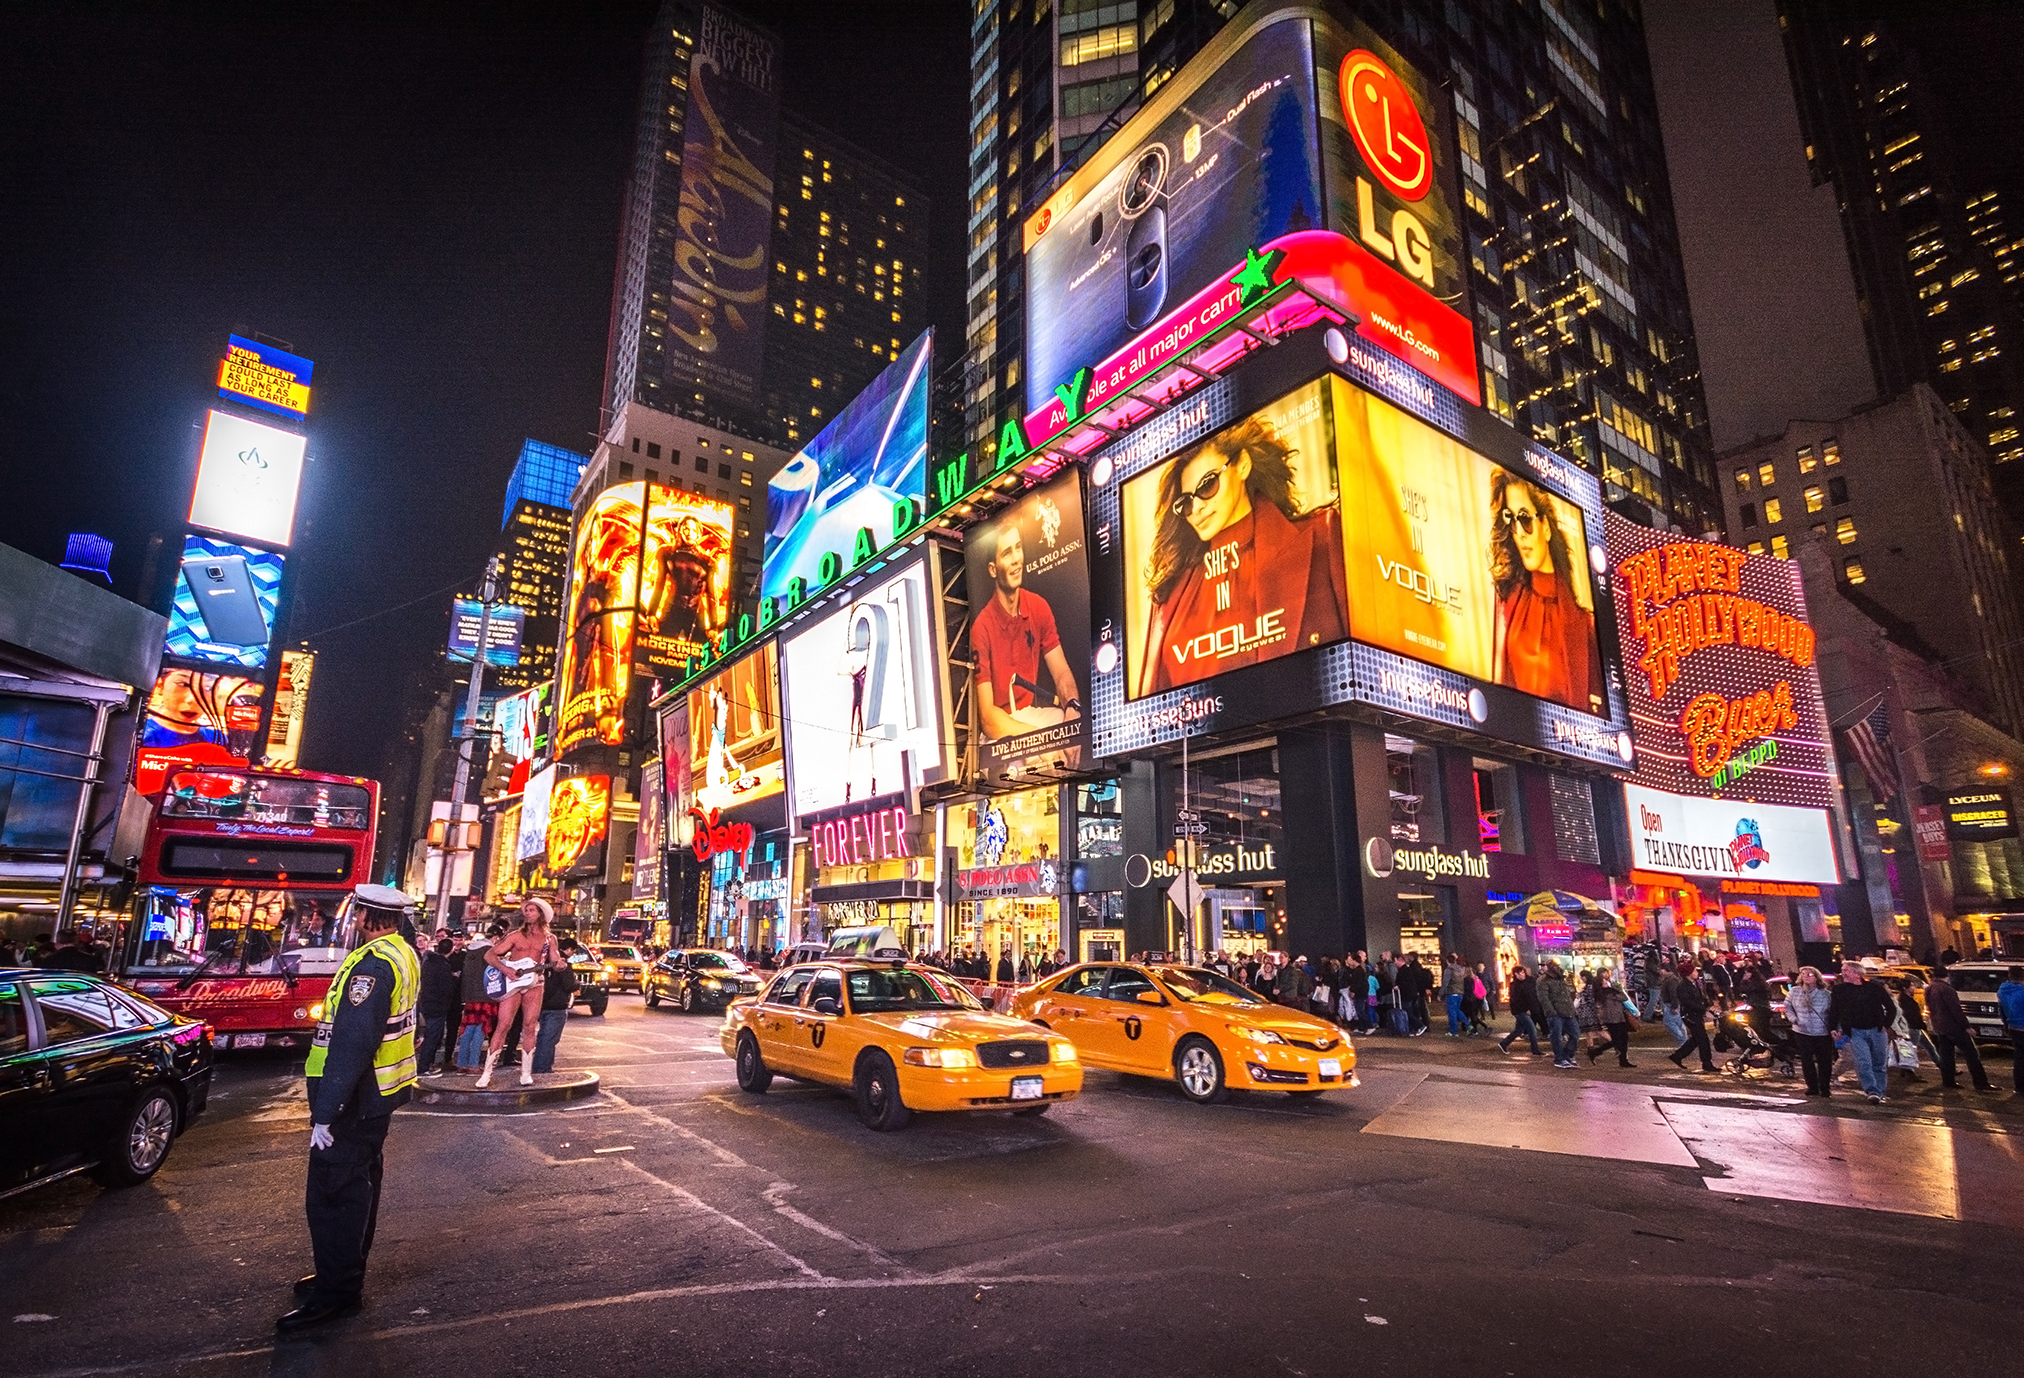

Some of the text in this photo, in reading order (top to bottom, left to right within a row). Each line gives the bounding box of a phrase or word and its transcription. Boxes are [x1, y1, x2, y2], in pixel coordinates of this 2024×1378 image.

[700, 37, 737, 72] NEW
[701, 18, 772, 72] BIGGEST
[1227, 81, 1272, 122] Dual Flash
[1356, 175, 1435, 288] LG
[1110, 365, 1126, 388] at
[1129, 350, 1147, 378] all
[1149, 315, 1197, 361] major
[1370, 311, 1441, 363] www.LG.com
[228, 353, 297, 382] RETIREMENT
[229, 344, 261, 363] YOUR
[227, 372, 289, 398] AS LONG AS
[229, 363, 292, 390] COULD LAST
[1350, 346, 1436, 409] sunglass hut
[226, 379, 299, 409] YOUR CAREER
[1288, 395, 1321, 423] MENDES
[1113, 400, 1210, 470] sunglass hut
[1523, 447, 1565, 482] sunglass
[760, 366, 1094, 632] BROADWAY
[1399, 483, 1429, 523] SHE'S
[1026, 538, 1083, 573] U.S. POLO ASSN.
[1411, 525, 1424, 555] IN
[1203, 540, 1240, 581] SHE'S
[1216, 580, 1231, 612] IN
[1618, 542, 1748, 639] PLANET
[667, 650, 688, 660] PART
[1239, 632, 1287, 653] eyewear
[1639, 593, 1817, 700] HOLLYWOOD
[648, 655, 688, 668] NOVEMB
[585, 727, 598, 739] 21
[992, 723, 1082, 757] LIVE AUTHENTICALLY
[1713, 739, 1778, 788] di BEPPO
[1948, 793, 2002, 805] LYCEUM
[1640, 804, 1664, 837] Open
[1916, 820, 1946, 834] JERSEY
[1950, 810, 2008, 822] DISGRACED
[811, 805, 910, 869] FOREVER
[1729, 833, 1754, 850] PLANET
[1922, 832, 1946, 843] BOYS
[1237, 844, 1277, 872] hut
[1395, 845, 1491, 880] sunglass hut
[969, 887, 1019, 898] SINCE 1890
[971, 869, 1003, 887] POLO
[1721, 879, 1820, 898] PLANET HOLLYWOOD
[828, 901, 867, 922] FOREVER
[182, 978, 289, 1011] Broadway
[1127, 1020, 1140, 1038] T
